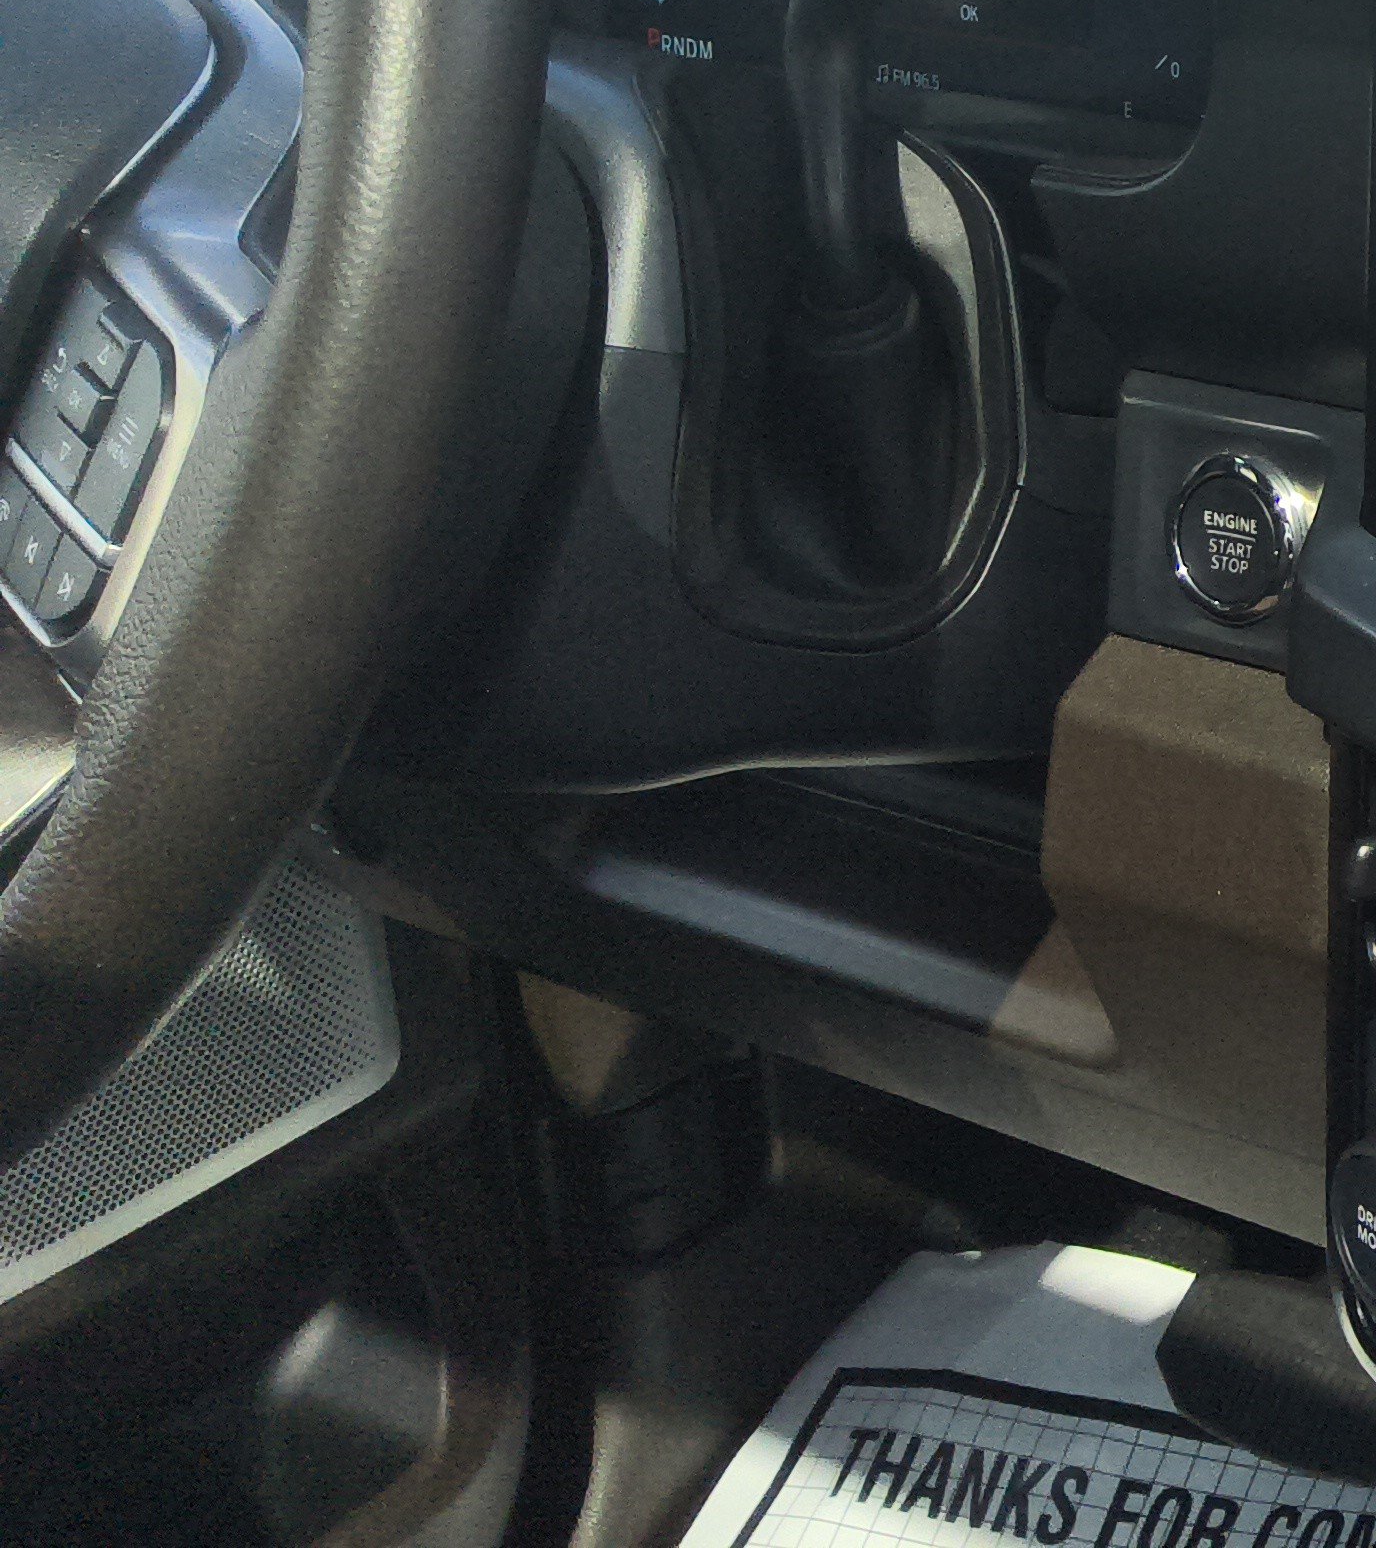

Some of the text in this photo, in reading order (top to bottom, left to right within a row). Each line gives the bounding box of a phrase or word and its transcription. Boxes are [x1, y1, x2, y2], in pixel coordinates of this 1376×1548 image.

[959, 4, 979, 23] OK
[892, 68, 911, 88] FM
[1203, 510, 1258, 535] ENGINE
[1208, 538, 1253, 559] START
[1210, 554, 1249, 574] STOP
[831, 1428, 1089, 1545] THANKS
[1093, 1478, 1243, 1548] FOR
